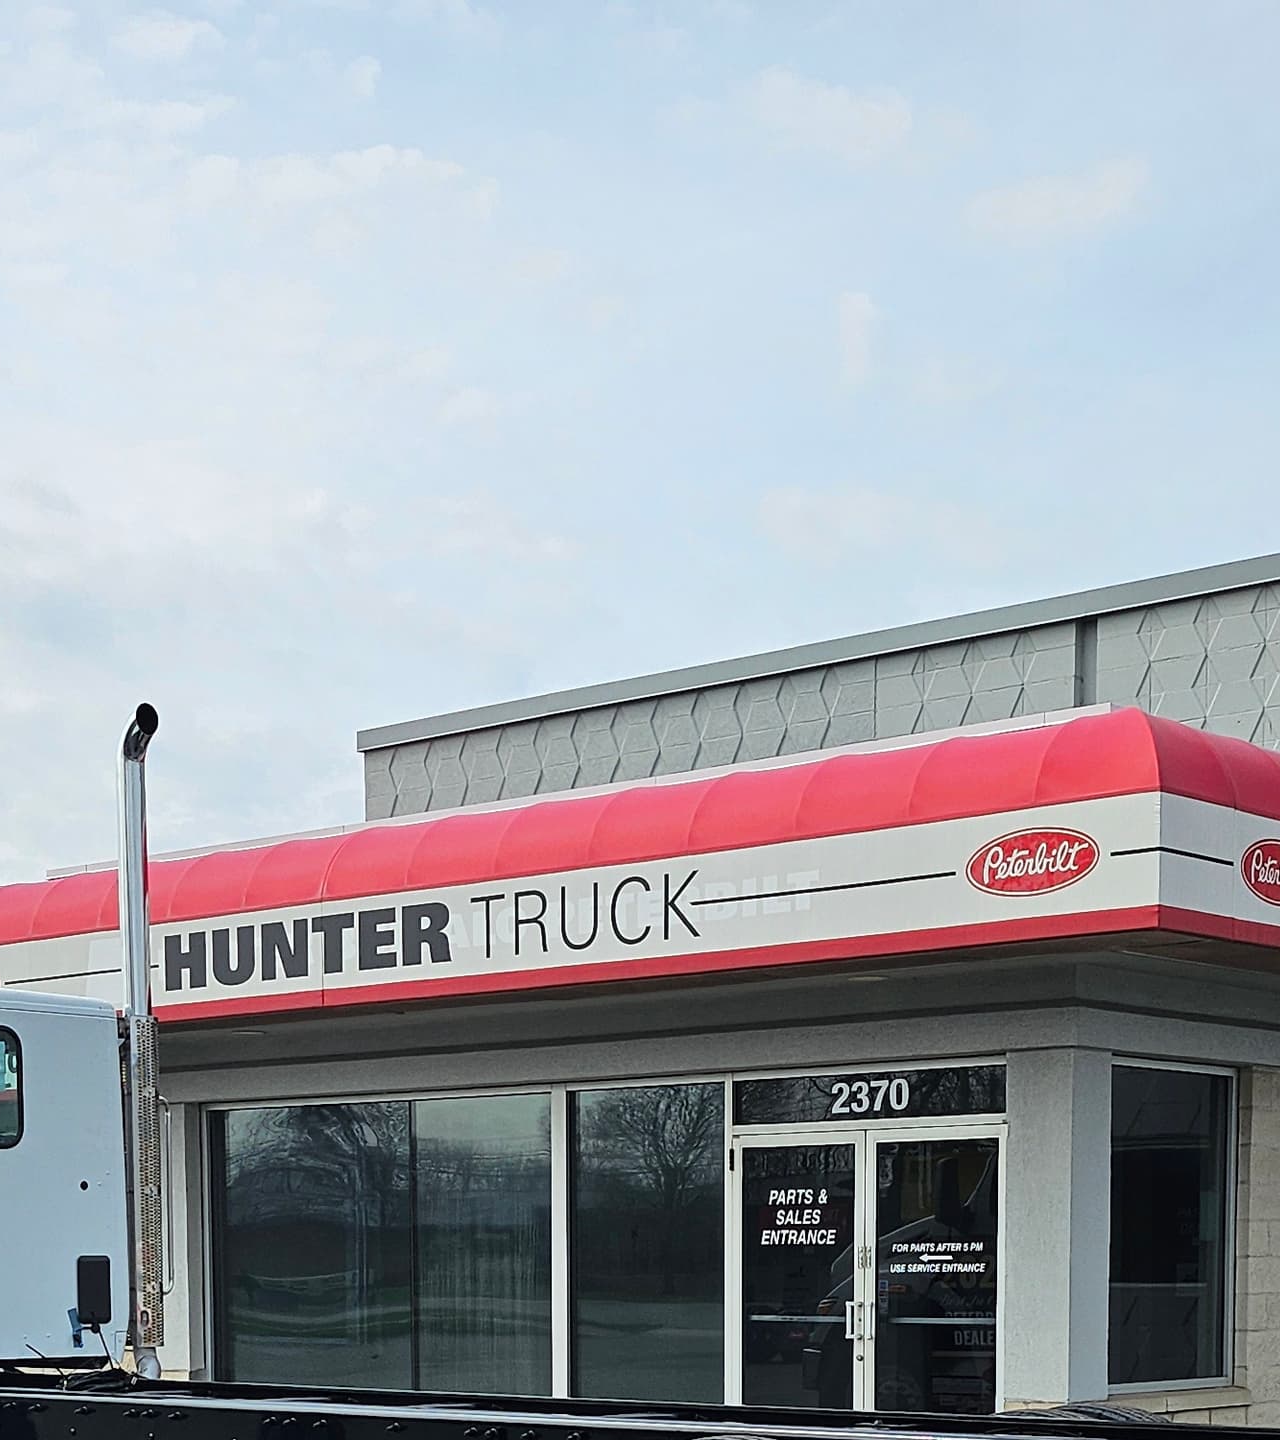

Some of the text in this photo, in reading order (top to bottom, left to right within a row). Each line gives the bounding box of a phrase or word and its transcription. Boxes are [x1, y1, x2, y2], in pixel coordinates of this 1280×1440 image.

[982, 841, 1088, 885] Peterbilt
[164, 901, 452, 991] HUNTER
[470, 869, 702, 959] TRUCK
[831, 1078, 910, 1114] 2370
[768, 1188, 828, 1205] PARTS &
[776, 1209, 820, 1225] SALES
[761, 1229, 836, 1245] ENTRANCE
[892, 1242, 983, 1253] FOR PARTS AFTER 5 PM
[890, 1263, 986, 1273] USE SERVICE ENTRANCE
[954, 1330, 995, 1346] DEALE
